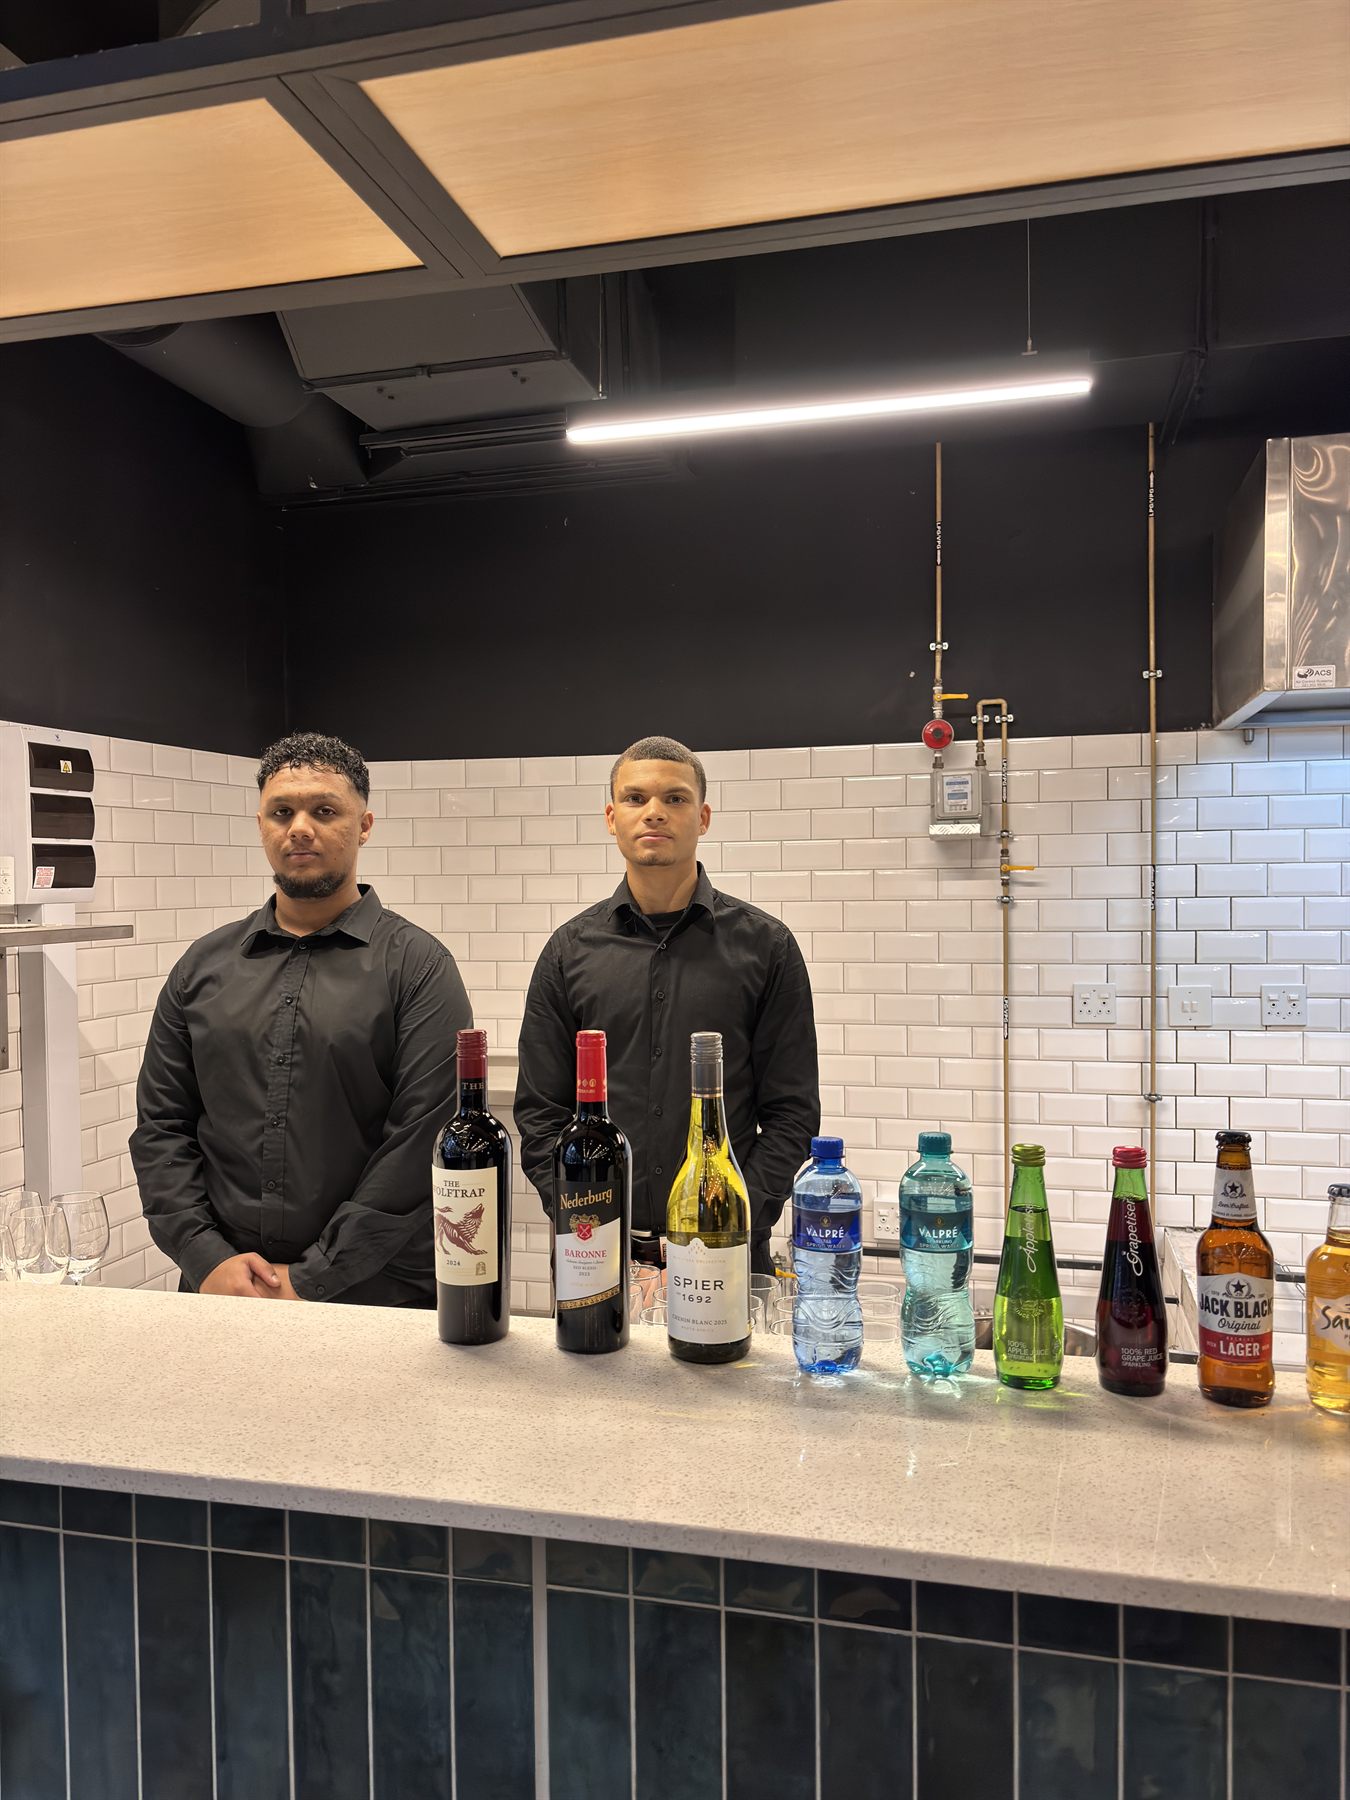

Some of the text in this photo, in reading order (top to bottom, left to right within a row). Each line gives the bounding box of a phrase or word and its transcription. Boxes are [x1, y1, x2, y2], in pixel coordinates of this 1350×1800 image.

[1314, 669, 1332, 677] ACS
[463, 1082, 485, 1090] THE
[443, 1180, 460, 1188] THE
[560, 1188, 613, 1210] Nederburg
[806, 1226, 845, 1239] VALPRÉ
[918, 1226, 958, 1239] VALPRÉ
[564, 1248, 607, 1259] BARONNE
[673, 1275, 725, 1291] SPIER
[682, 1293, 712, 1304] 1692
[1200, 1293, 1273, 1319] JACK BLACK
[1217, 1317, 1261, 1333] Original
[1007, 1340, 1027, 1349] 100%
[1219, 1340, 1260, 1357] LAGER
[1007, 1347, 1029, 1356] APPLE
[1121, 1347, 1158, 1355] 100% RED
[1121, 1354, 1146, 1362] GRAPE
